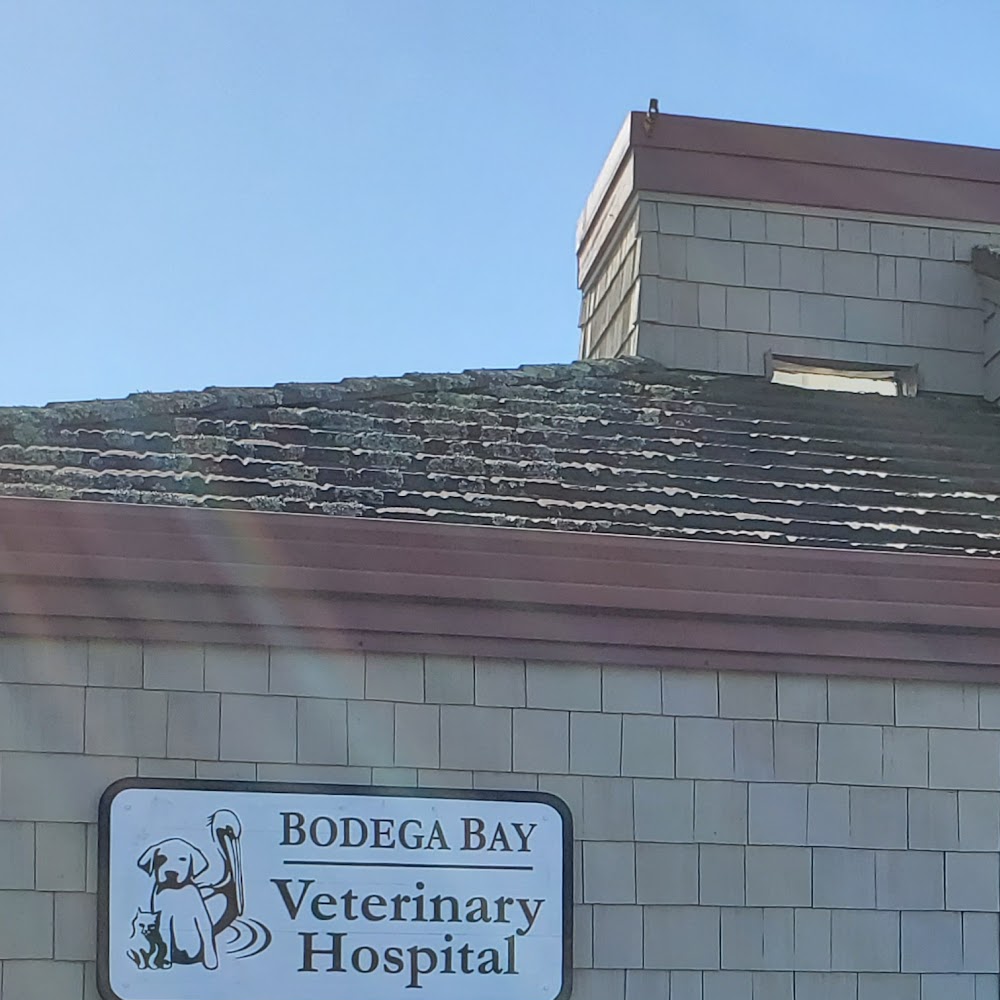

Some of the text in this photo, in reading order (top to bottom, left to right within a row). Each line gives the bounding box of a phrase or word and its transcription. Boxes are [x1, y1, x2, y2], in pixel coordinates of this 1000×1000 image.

[279, 812, 538, 852] BODEGA BAY
[270, 878, 546, 935] Veterinary
[297, 931, 520, 988] Hospital
